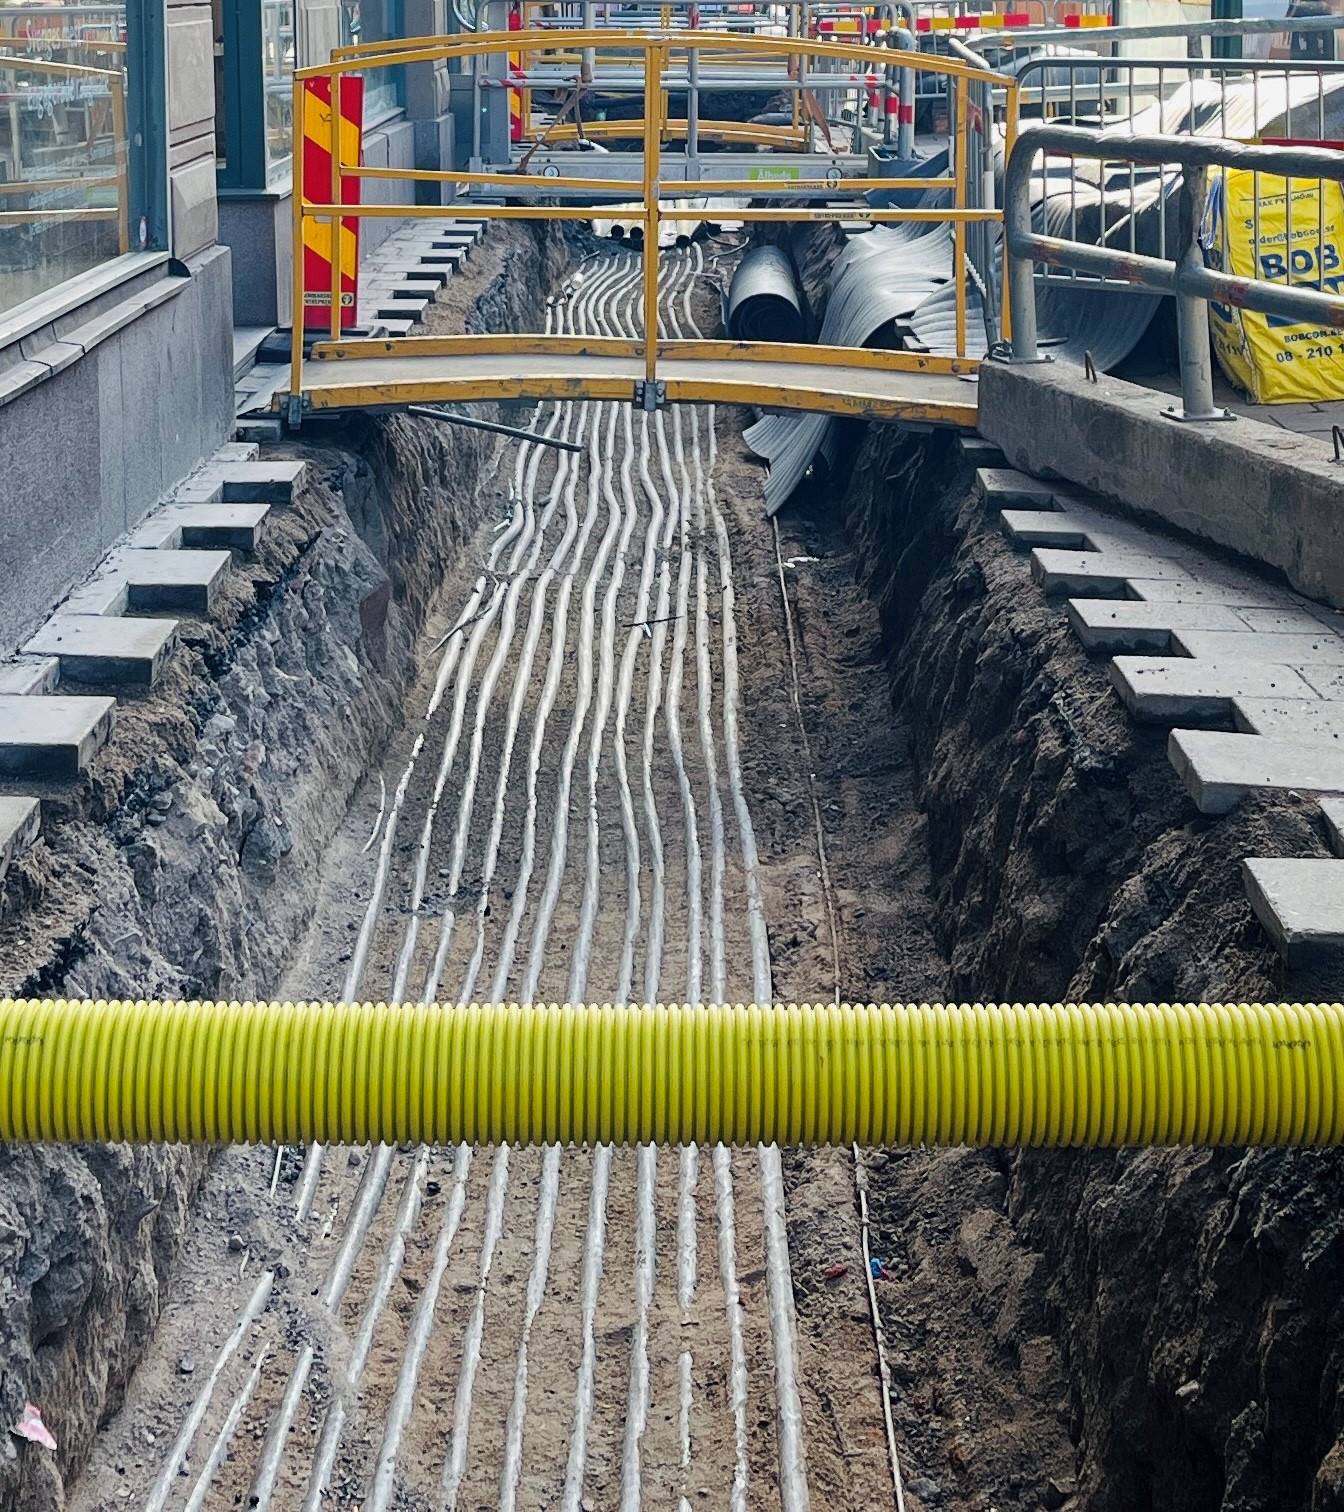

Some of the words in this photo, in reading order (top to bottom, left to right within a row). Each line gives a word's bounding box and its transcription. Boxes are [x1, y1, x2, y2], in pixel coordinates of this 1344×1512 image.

[1258, 243, 1340, 279] BOB
[1276, 351, 1294, 363] 08
[1306, 345, 1333, 360] 210
